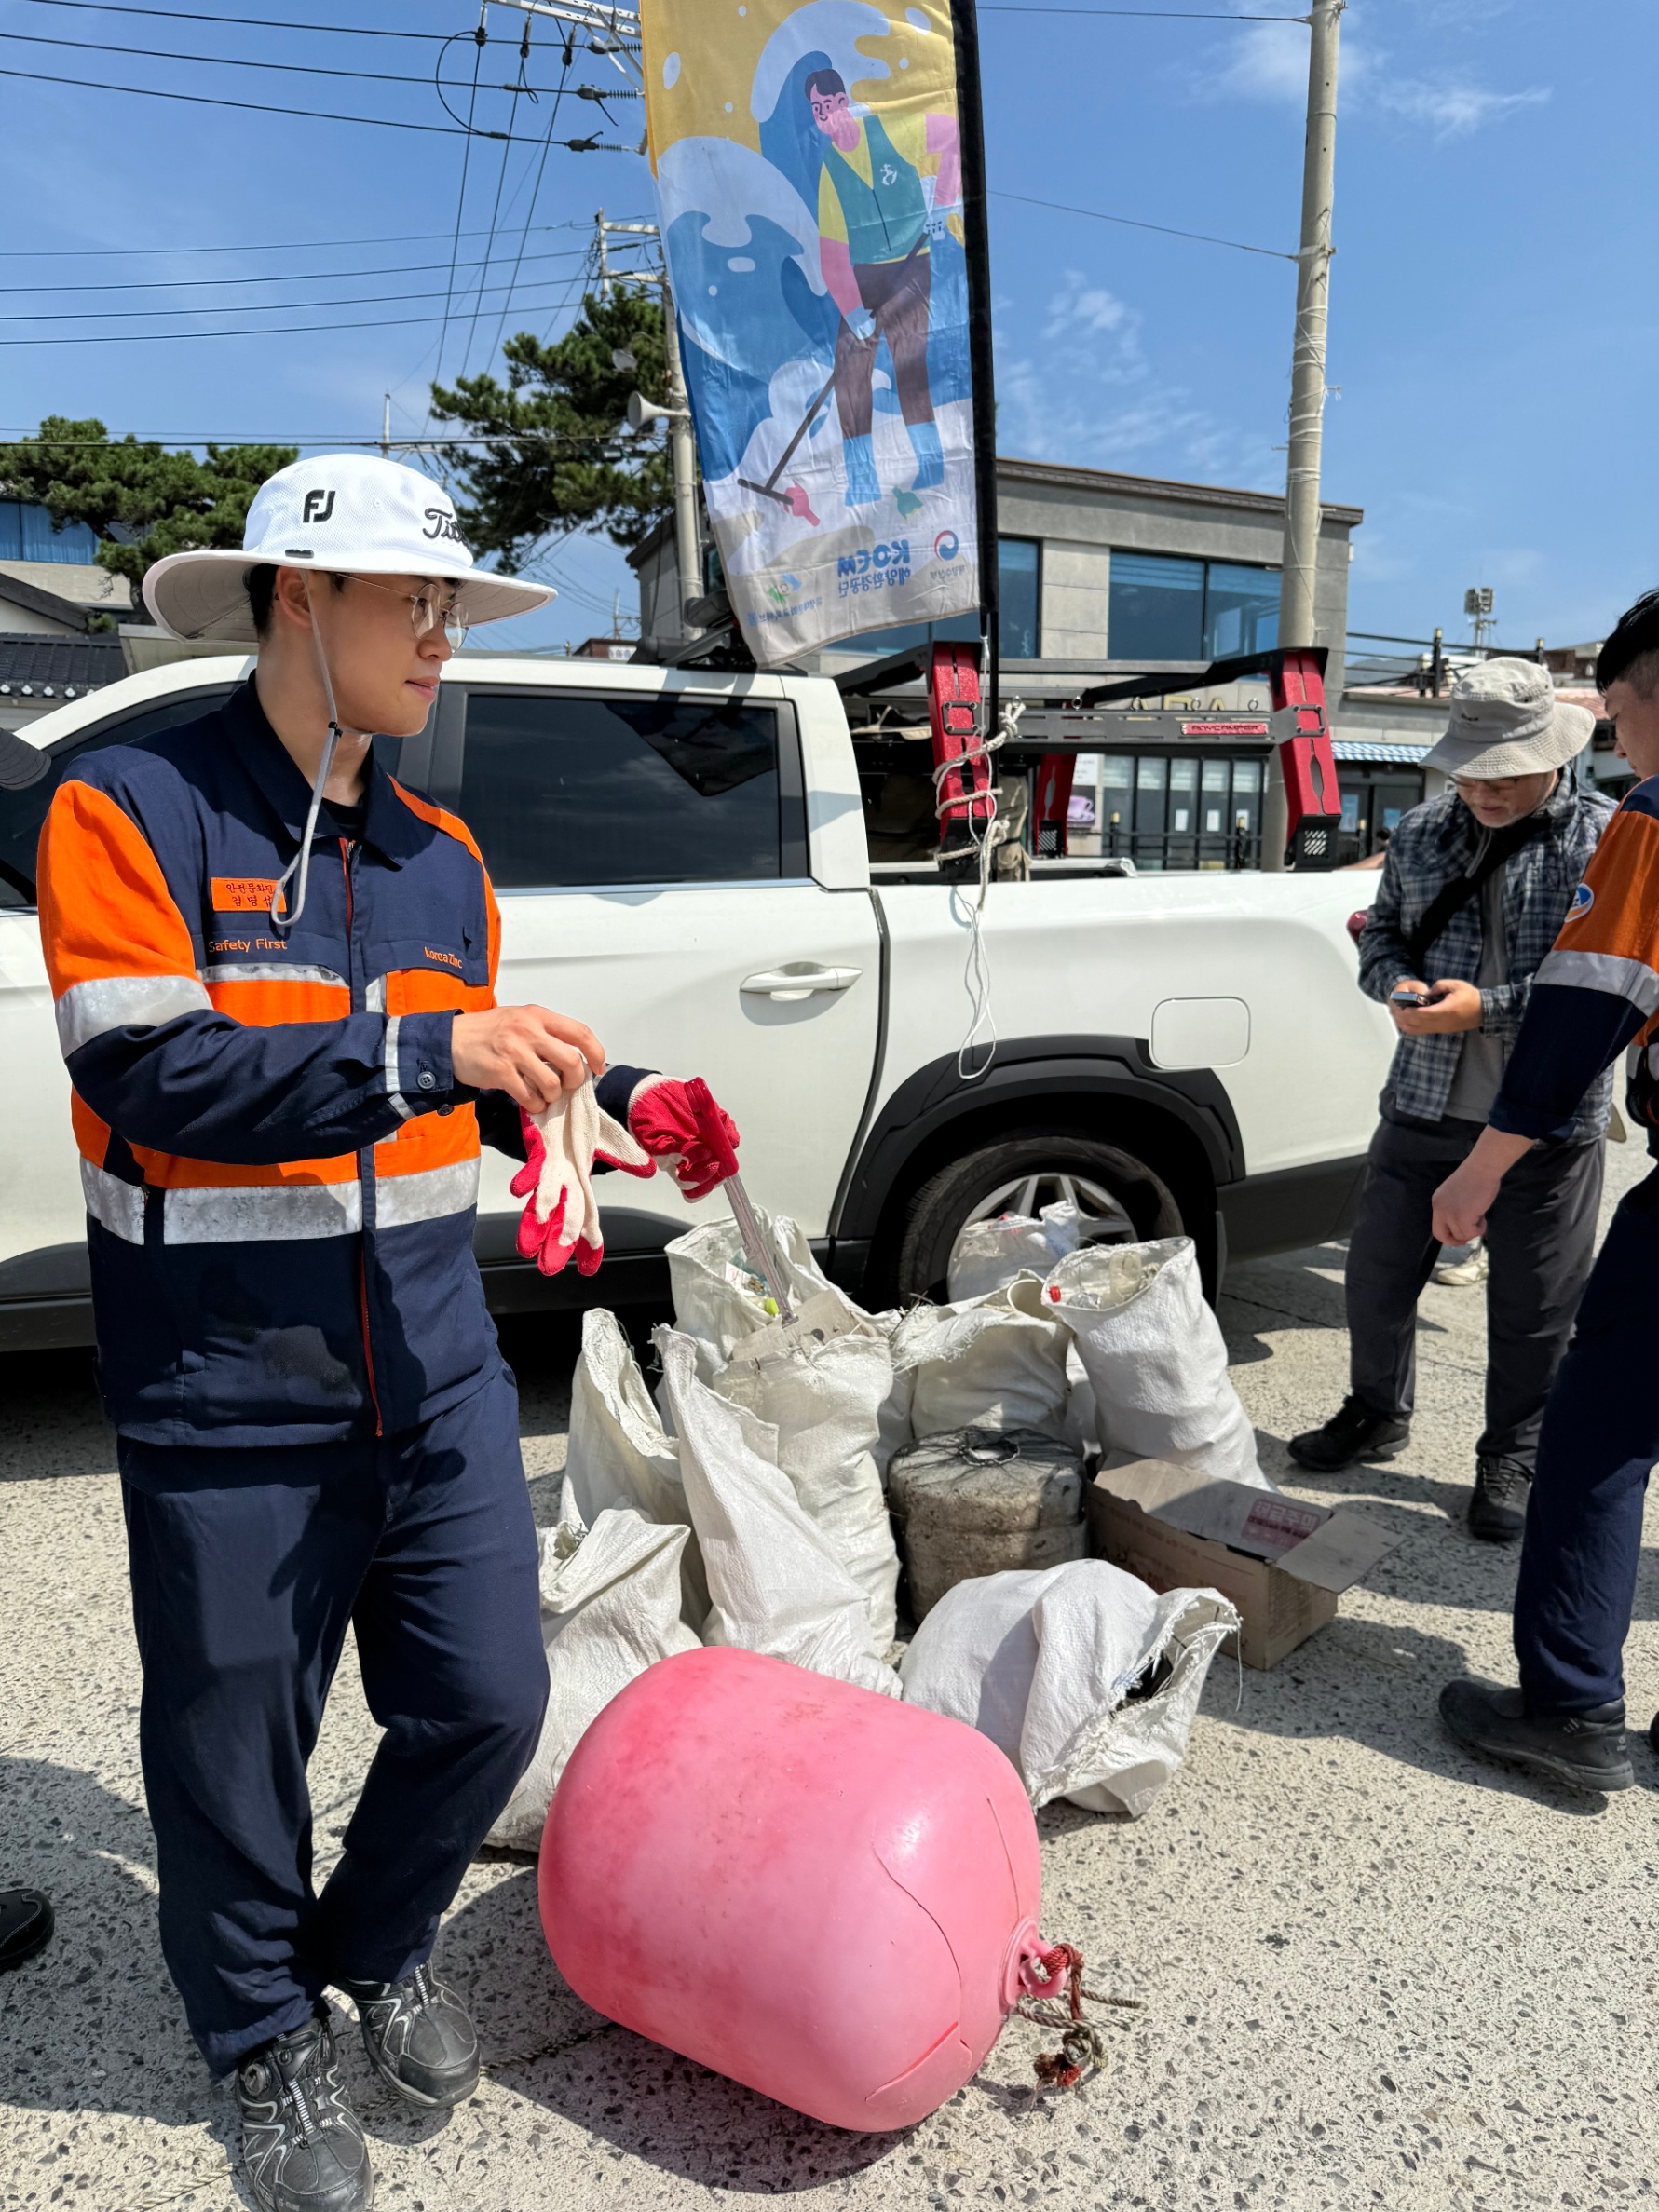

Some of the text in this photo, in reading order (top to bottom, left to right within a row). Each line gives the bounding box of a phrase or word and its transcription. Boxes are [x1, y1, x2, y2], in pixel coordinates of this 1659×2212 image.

[303, 489, 336, 523] FJ
[208, 937, 288, 953] Safety First
